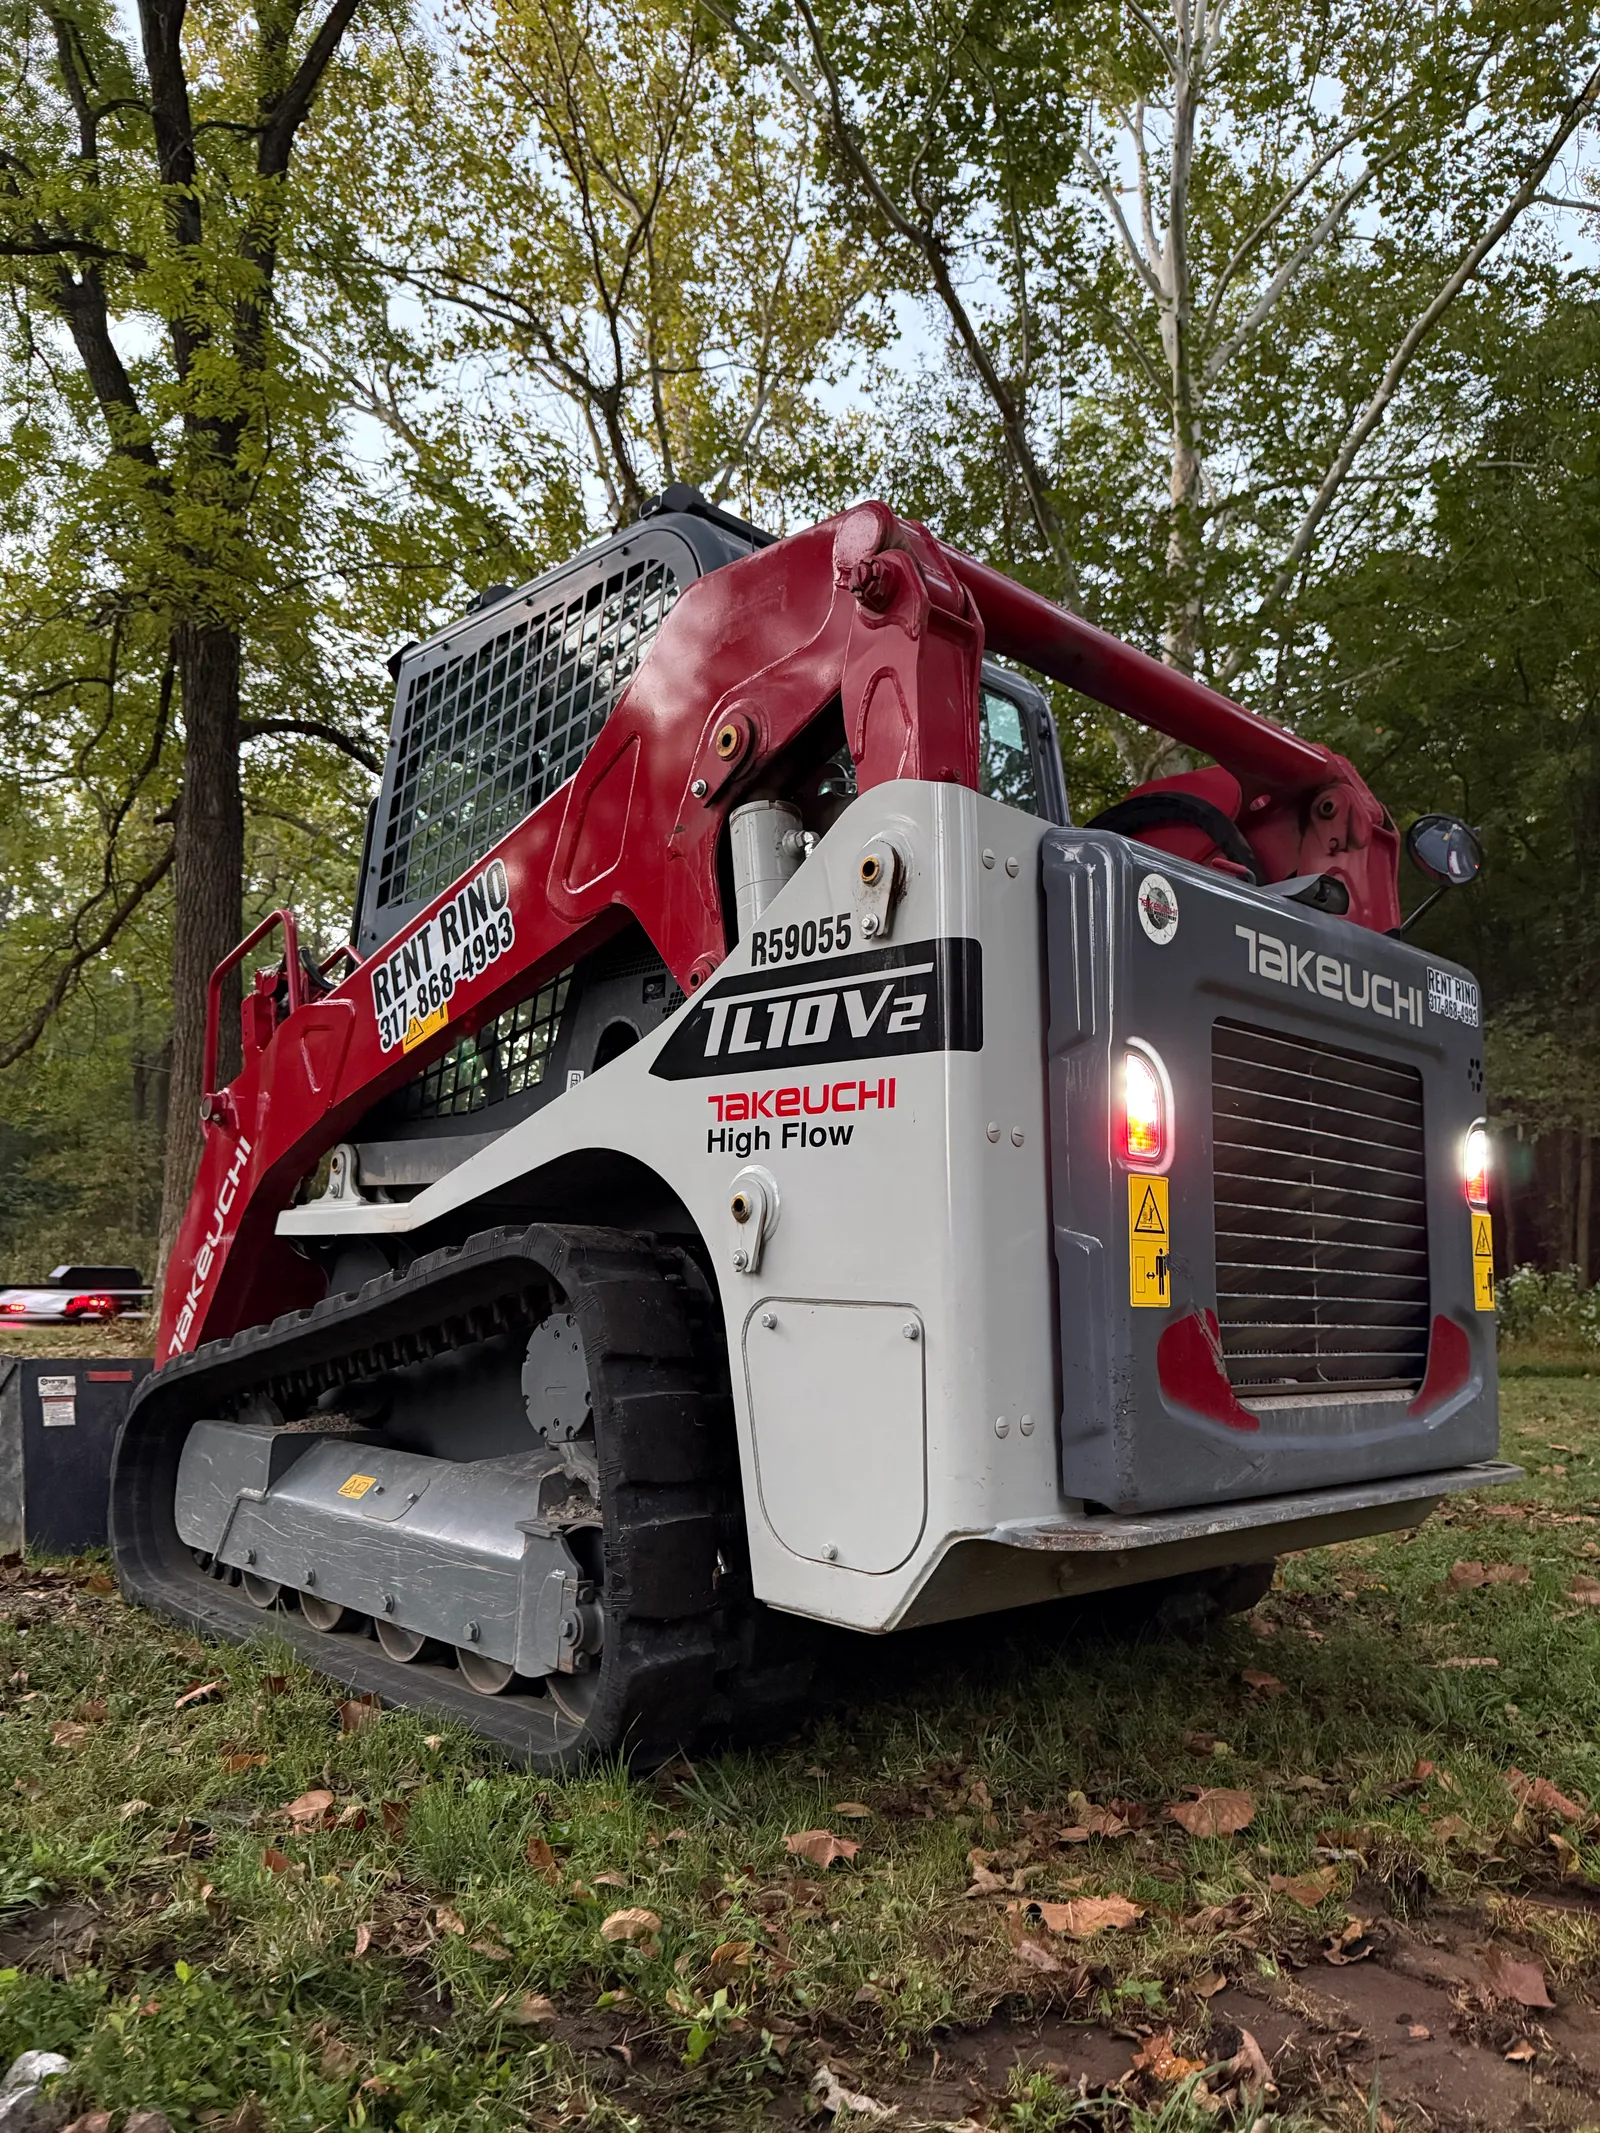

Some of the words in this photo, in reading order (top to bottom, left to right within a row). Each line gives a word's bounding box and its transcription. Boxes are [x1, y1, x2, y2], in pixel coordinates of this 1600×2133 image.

[372, 925, 432, 1015] RENT
[438, 861, 508, 956] RINO
[751, 912, 851, 967] R59055
[379, 911, 514, 1050] 317-868-4993
[1427, 968, 1452, 998] RENT
[1454, 978, 1477, 1008] RINO
[701, 962, 934, 1058] TL10V2
[1428, 993, 1477, 1026] 317-868-4993
[706, 1125, 771, 1159] High
[781, 1122, 855, 1149] Flow
